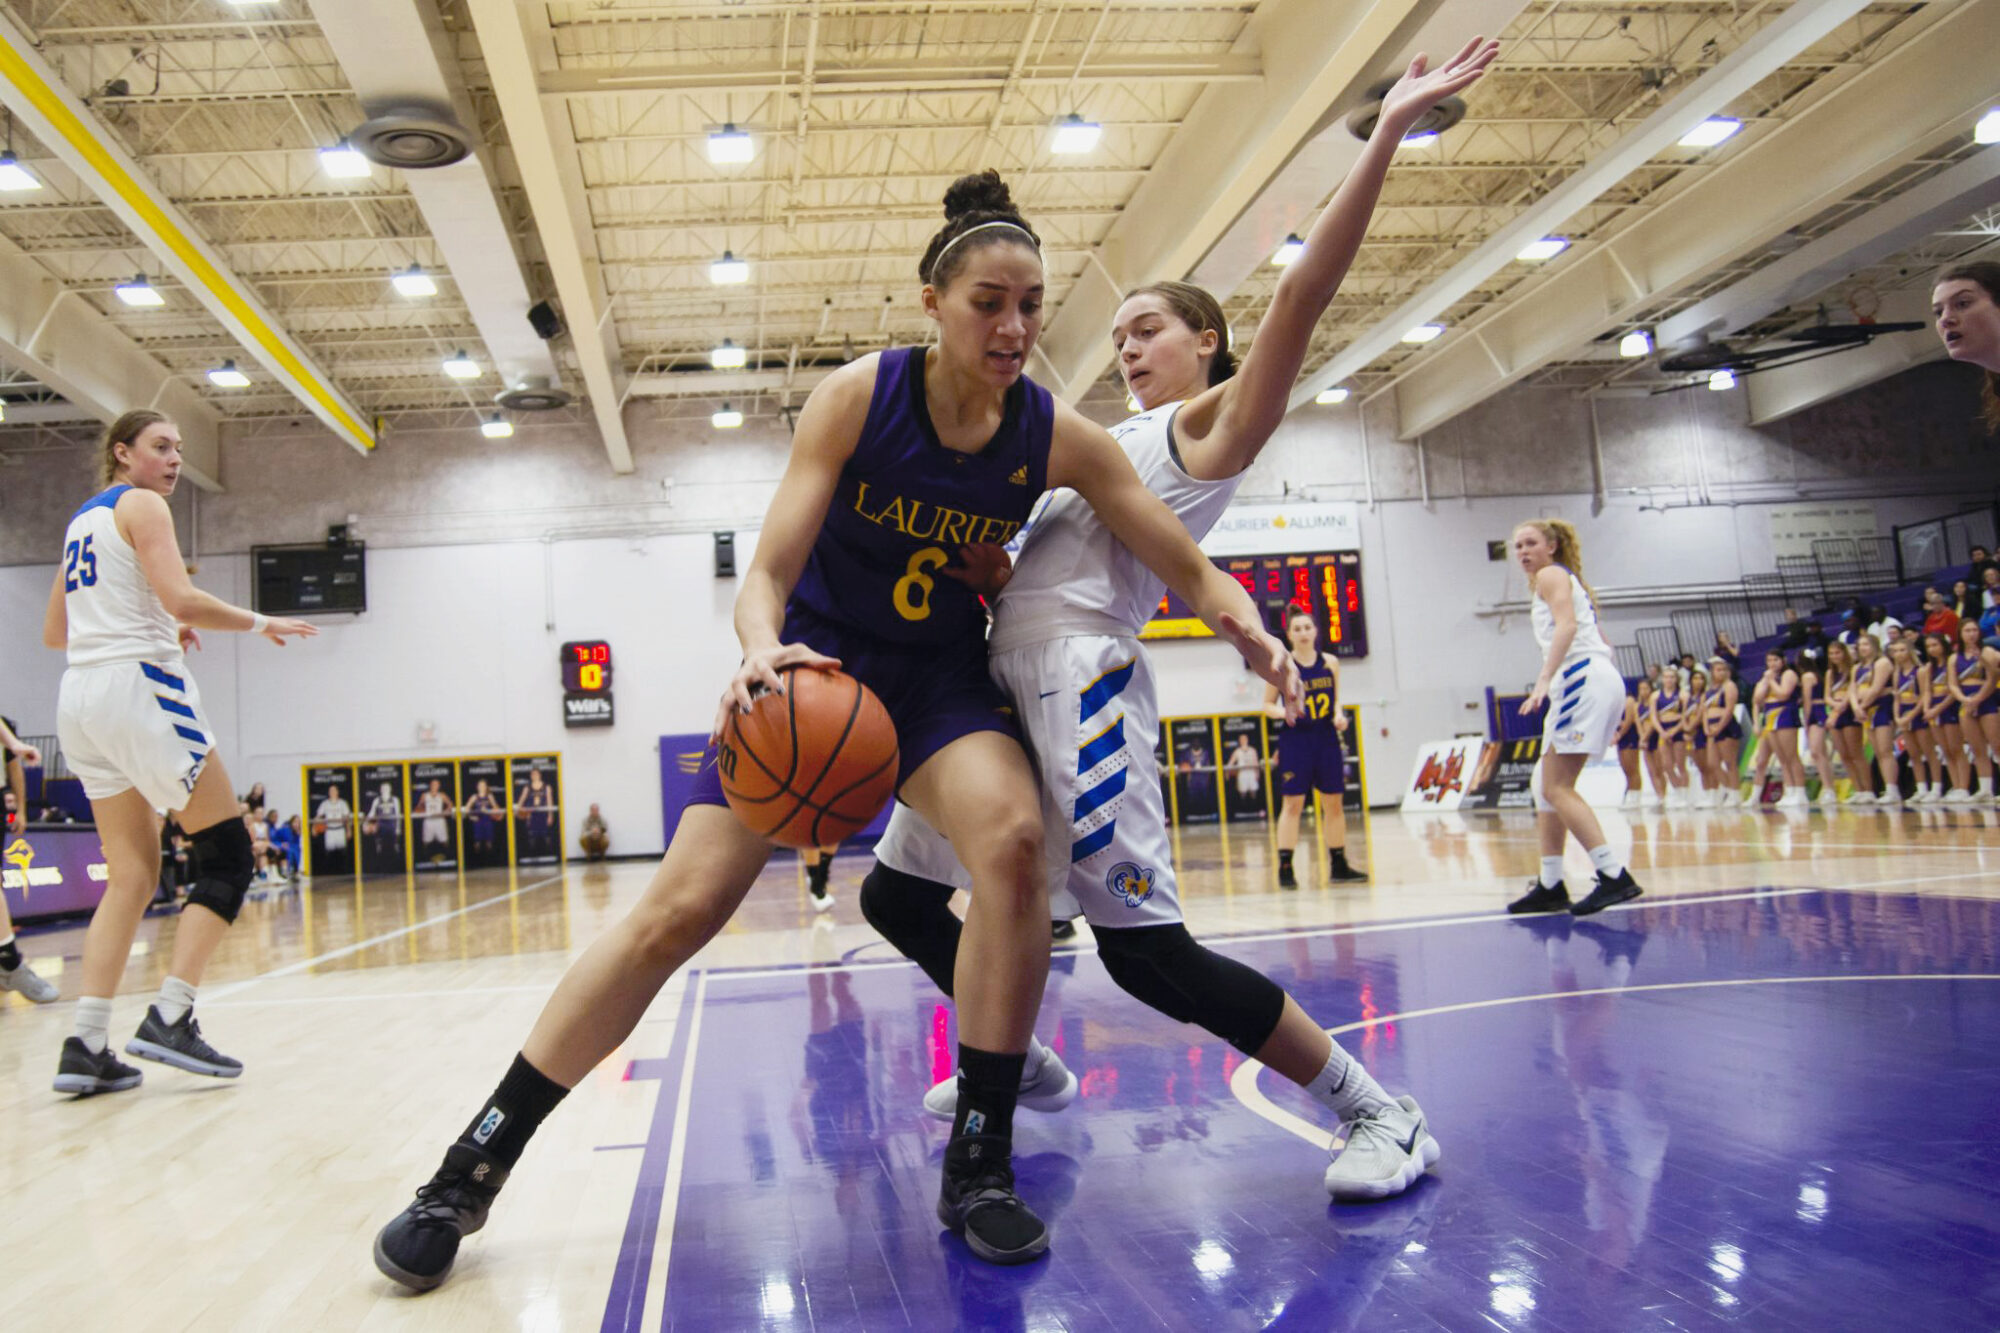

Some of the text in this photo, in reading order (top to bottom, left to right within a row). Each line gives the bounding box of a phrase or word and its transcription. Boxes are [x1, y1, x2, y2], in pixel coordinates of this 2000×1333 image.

[854, 481, 1021, 544] LAURIER
[1289, 515, 1347, 529] ALUMNI
[65, 533, 97, 593] 25
[893, 547, 948, 621] 6
[1305, 693, 1330, 719] 12
